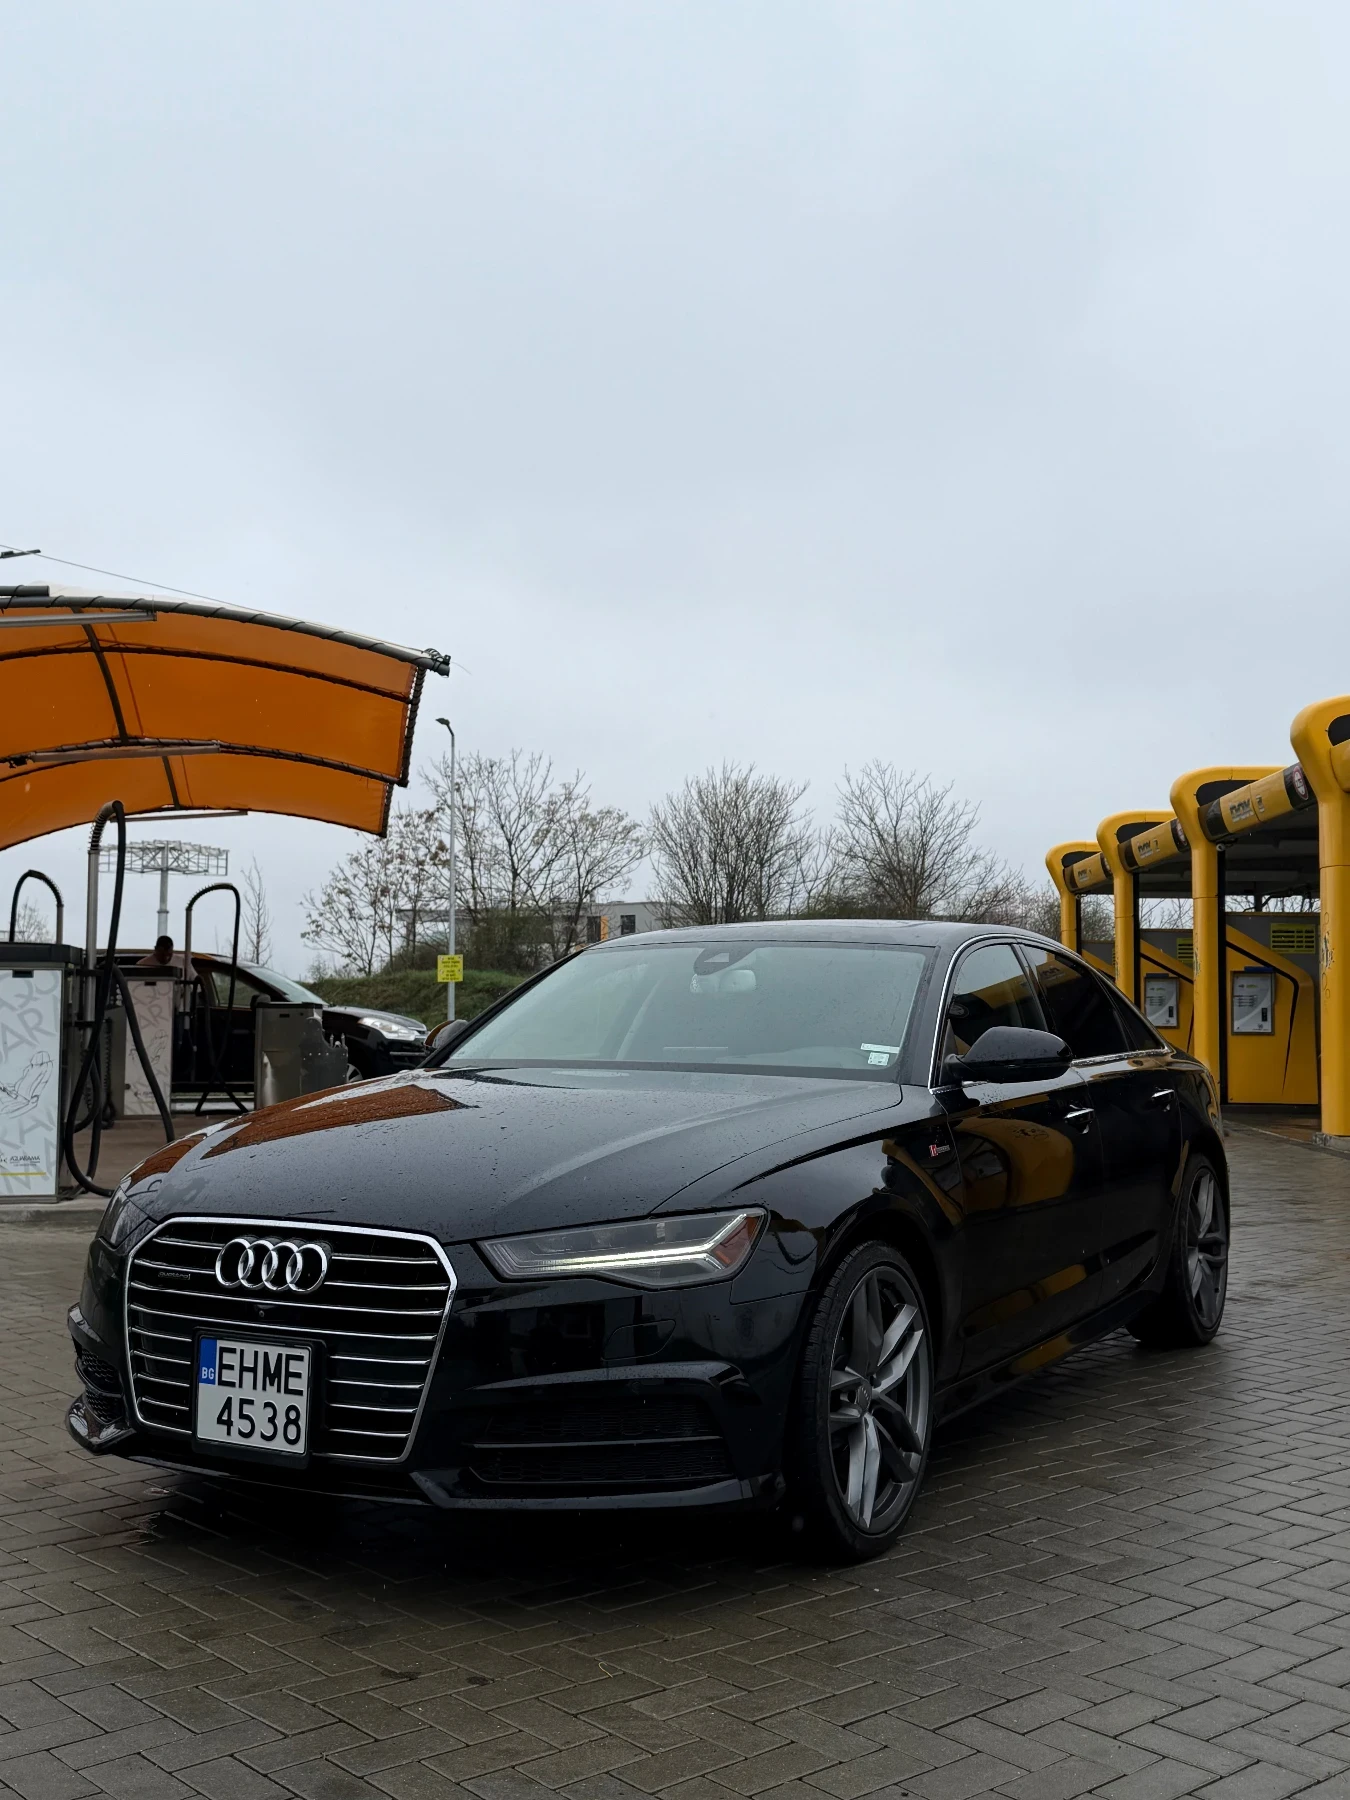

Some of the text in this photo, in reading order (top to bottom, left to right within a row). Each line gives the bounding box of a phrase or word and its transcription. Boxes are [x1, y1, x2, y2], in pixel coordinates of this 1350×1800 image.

[201, 1366, 215, 1380] BG
[217, 1346, 305, 1396] EHME
[216, 1396, 302, 1446] 4538
